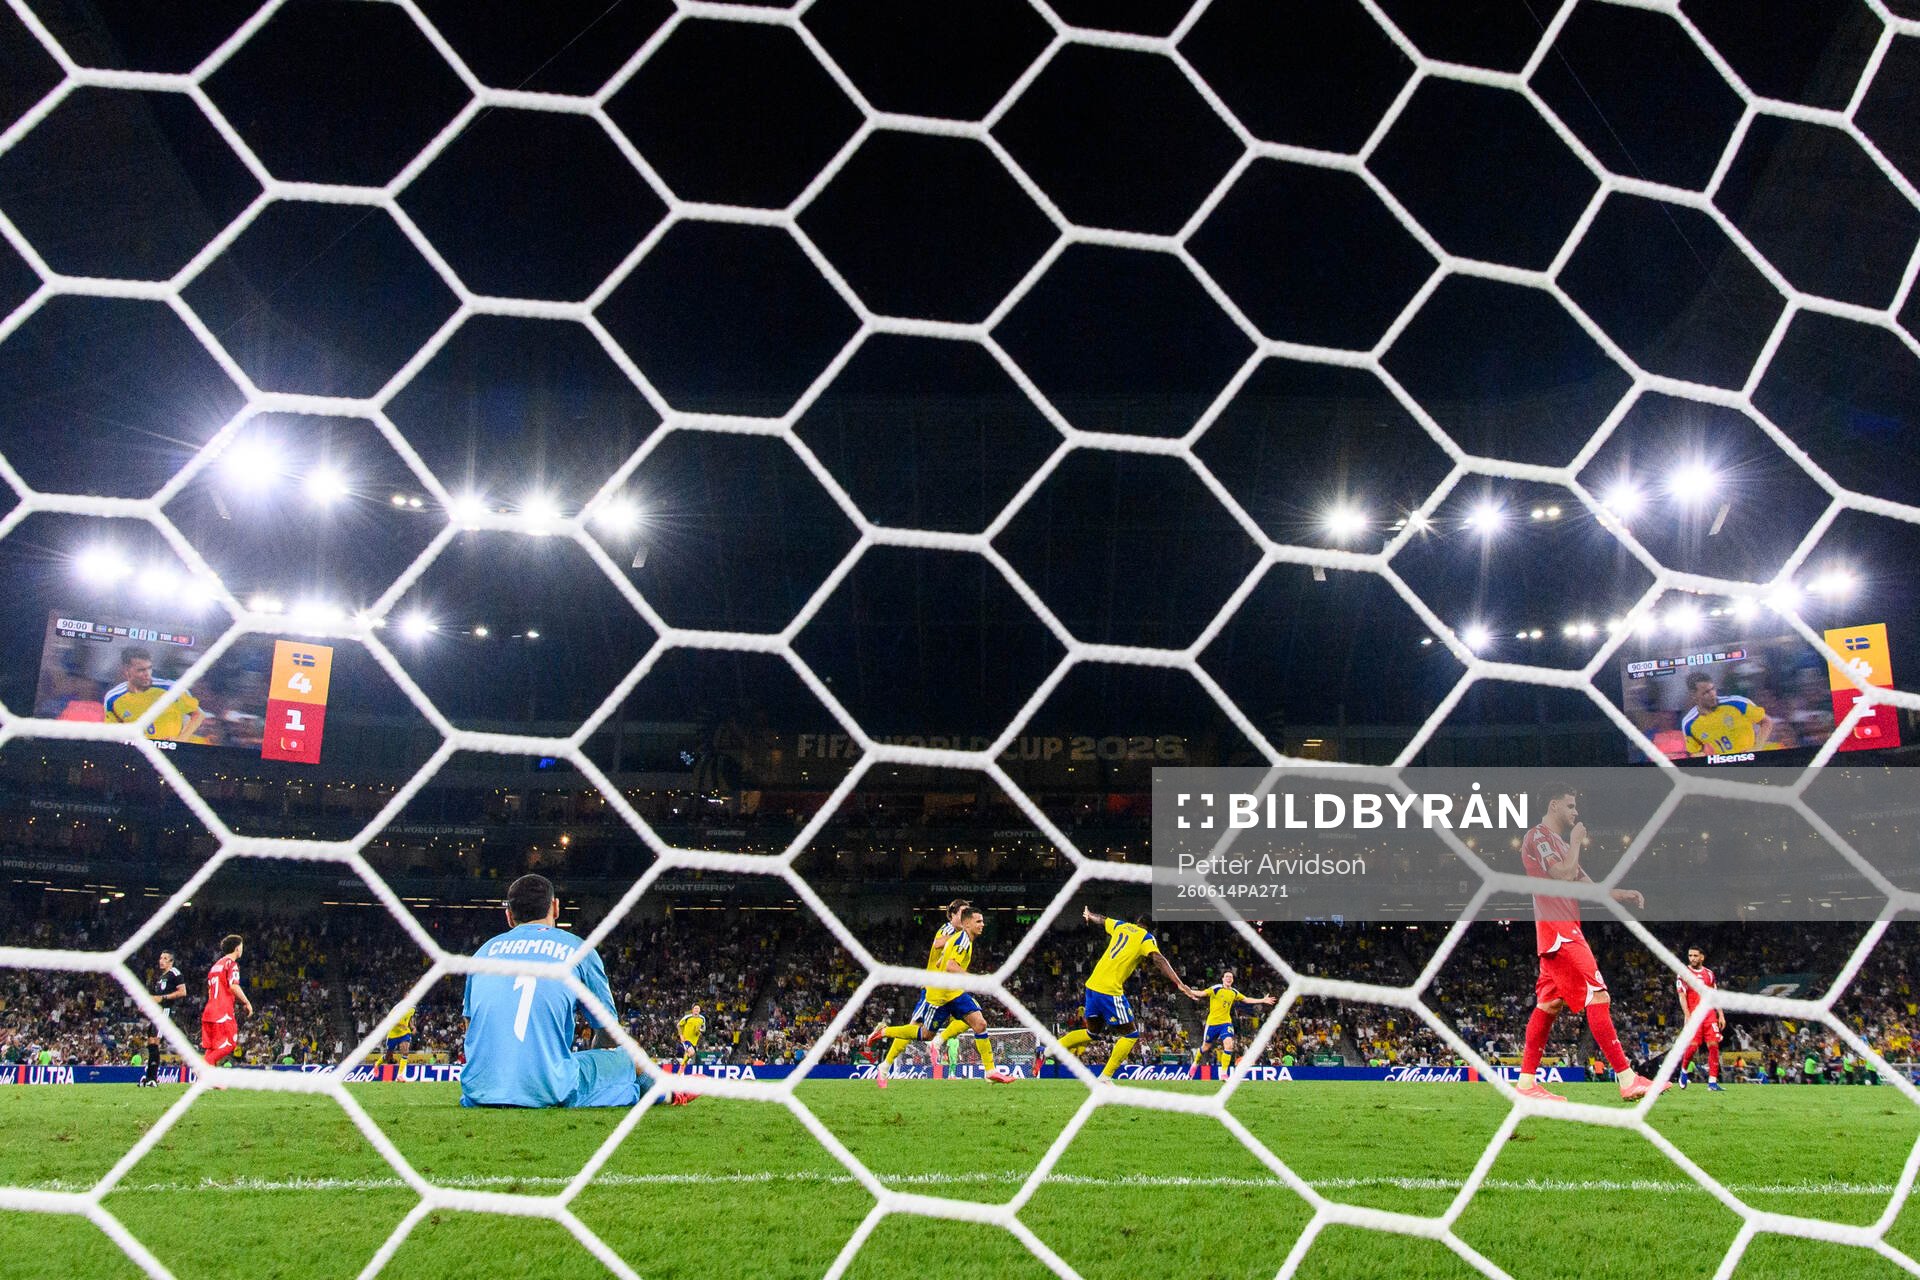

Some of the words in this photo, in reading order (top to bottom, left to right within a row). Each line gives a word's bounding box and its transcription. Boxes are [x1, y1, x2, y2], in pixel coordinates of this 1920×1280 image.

[62, 620, 88, 631] 90:00
[1631, 661, 1653, 671] 90:00
[287, 672, 312, 694] 4
[285, 709, 305, 731] 1
[1070, 735, 1187, 761] 2026
[1707, 753, 1755, 765] Hisense
[30, 800, 121, 815] MONTERREY
[654, 883, 736, 892] MONTERREY
[1110, 932, 1129, 959] 11
[513, 974, 537, 1043] 1
[29, 1066, 75, 1084] ULTRA
[399, 1065, 463, 1082] ULTR
[1217, 1067, 1294, 1081] UTRA
[1384, 1066, 1461, 1082] Michelob
